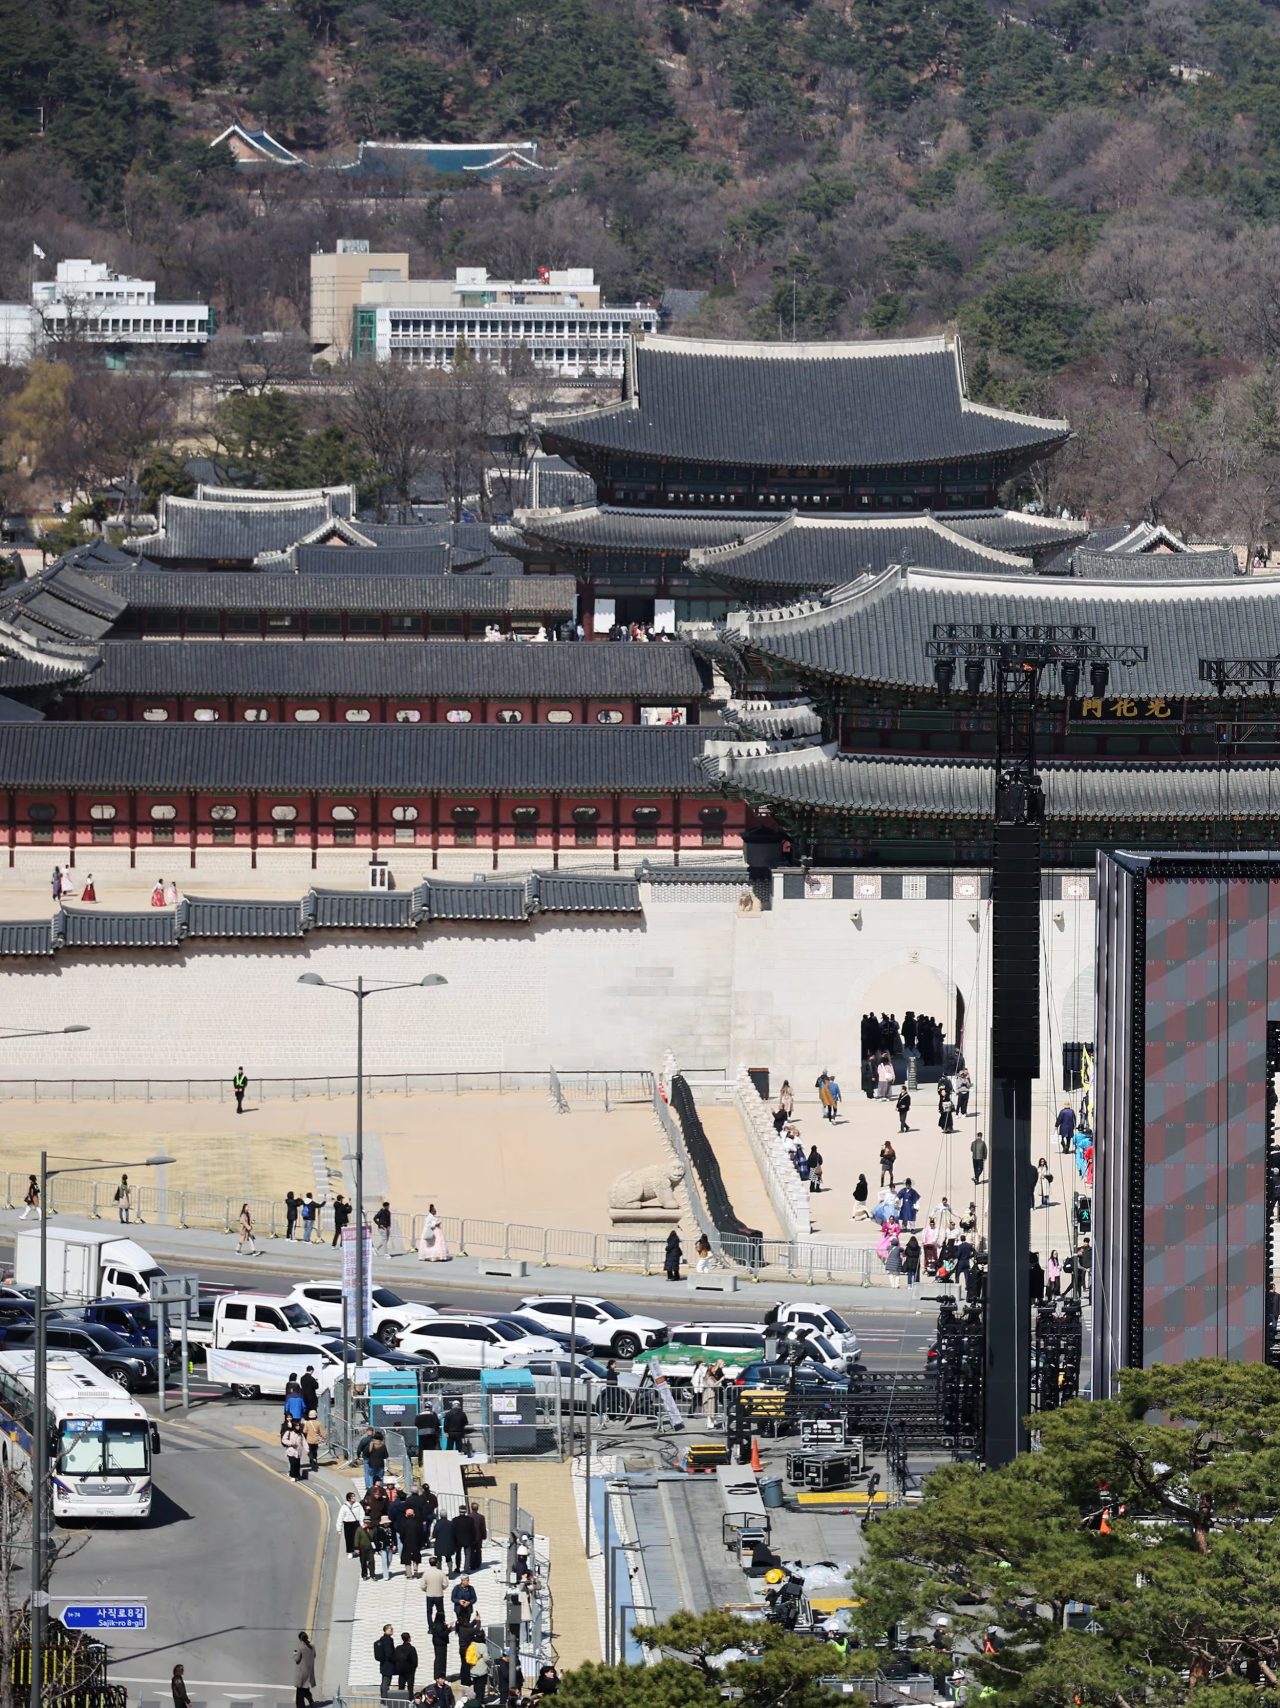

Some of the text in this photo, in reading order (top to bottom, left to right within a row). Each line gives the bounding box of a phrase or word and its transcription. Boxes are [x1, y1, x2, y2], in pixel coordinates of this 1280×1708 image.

[97, 1608, 144, 1618] 사직로8길
[98, 1619, 144, 1627] Sajik-ro 8-gil
